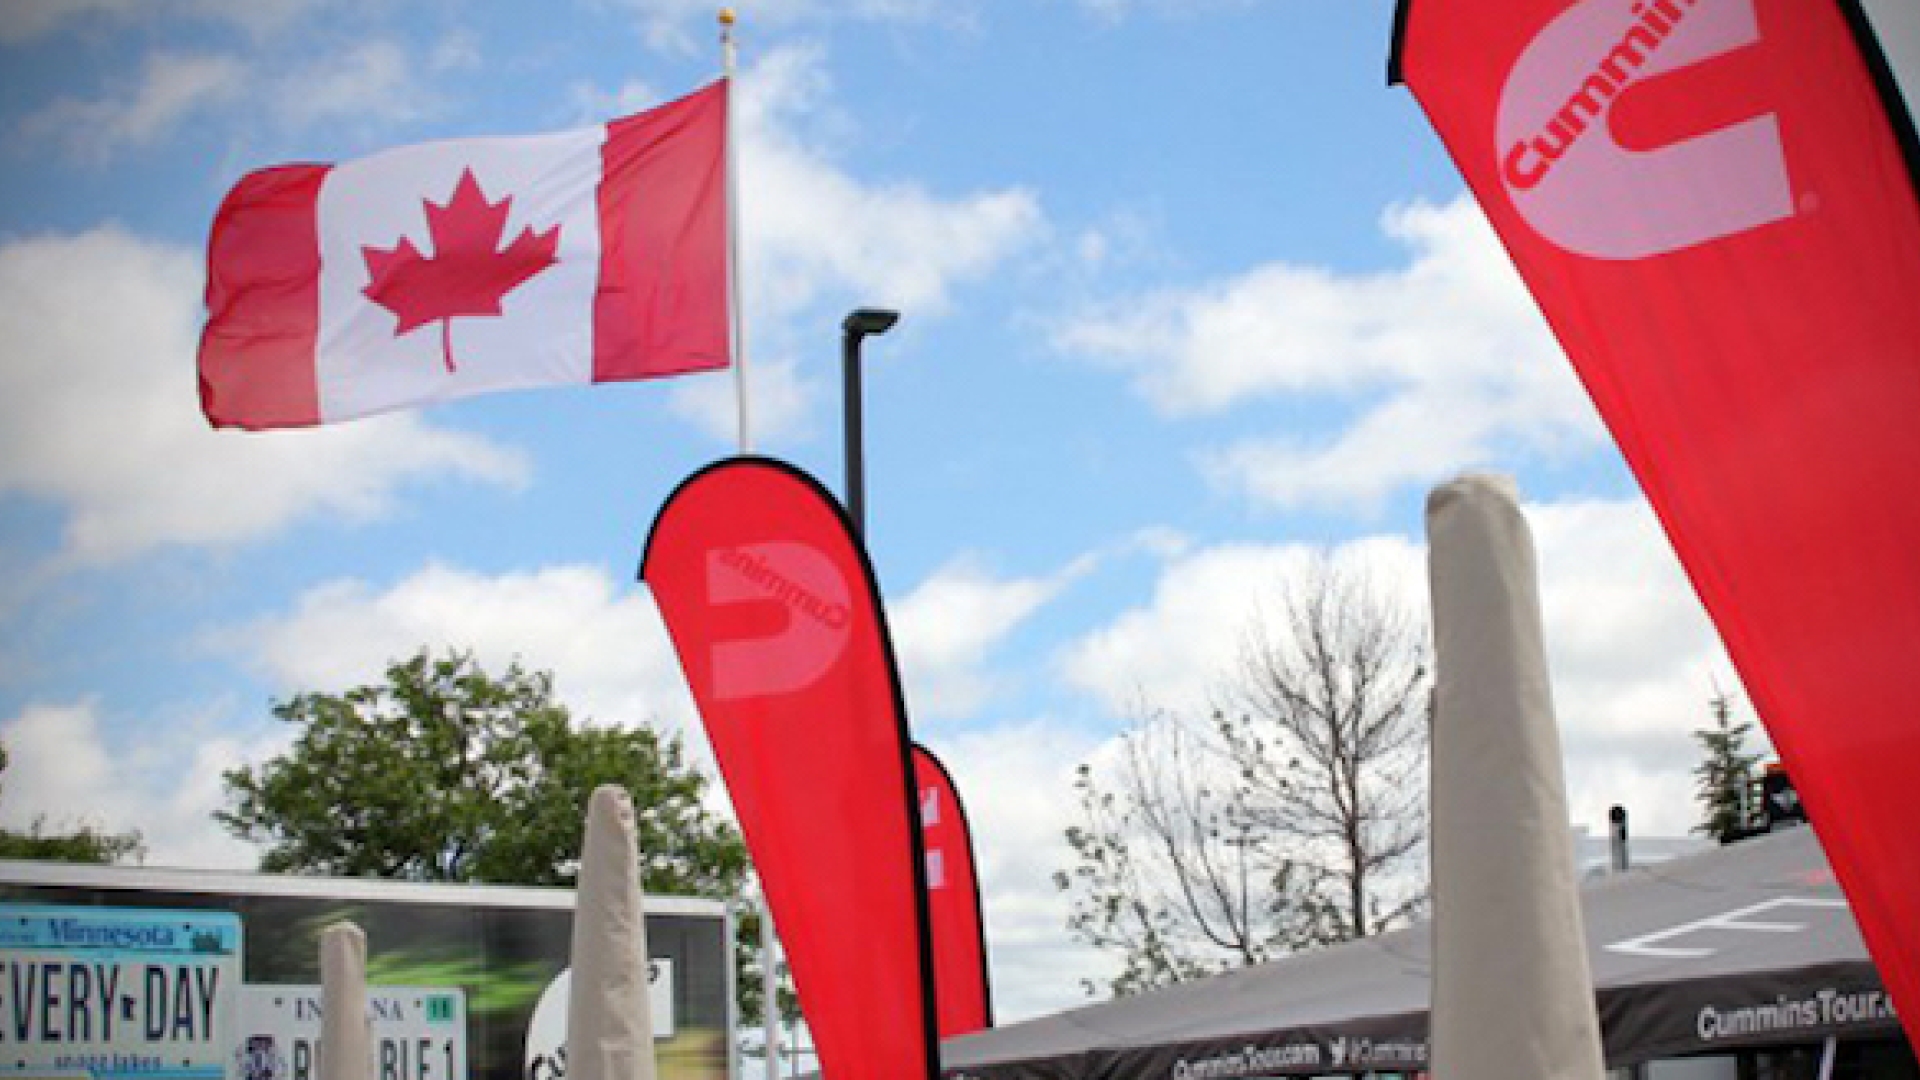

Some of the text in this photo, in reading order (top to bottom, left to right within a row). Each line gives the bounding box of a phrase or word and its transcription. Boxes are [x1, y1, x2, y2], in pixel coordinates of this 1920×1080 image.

[49, 917, 174, 946] Minnesota
[0, 962, 220, 1042] VERY DAY
[294, 997, 404, 1021] INNA
